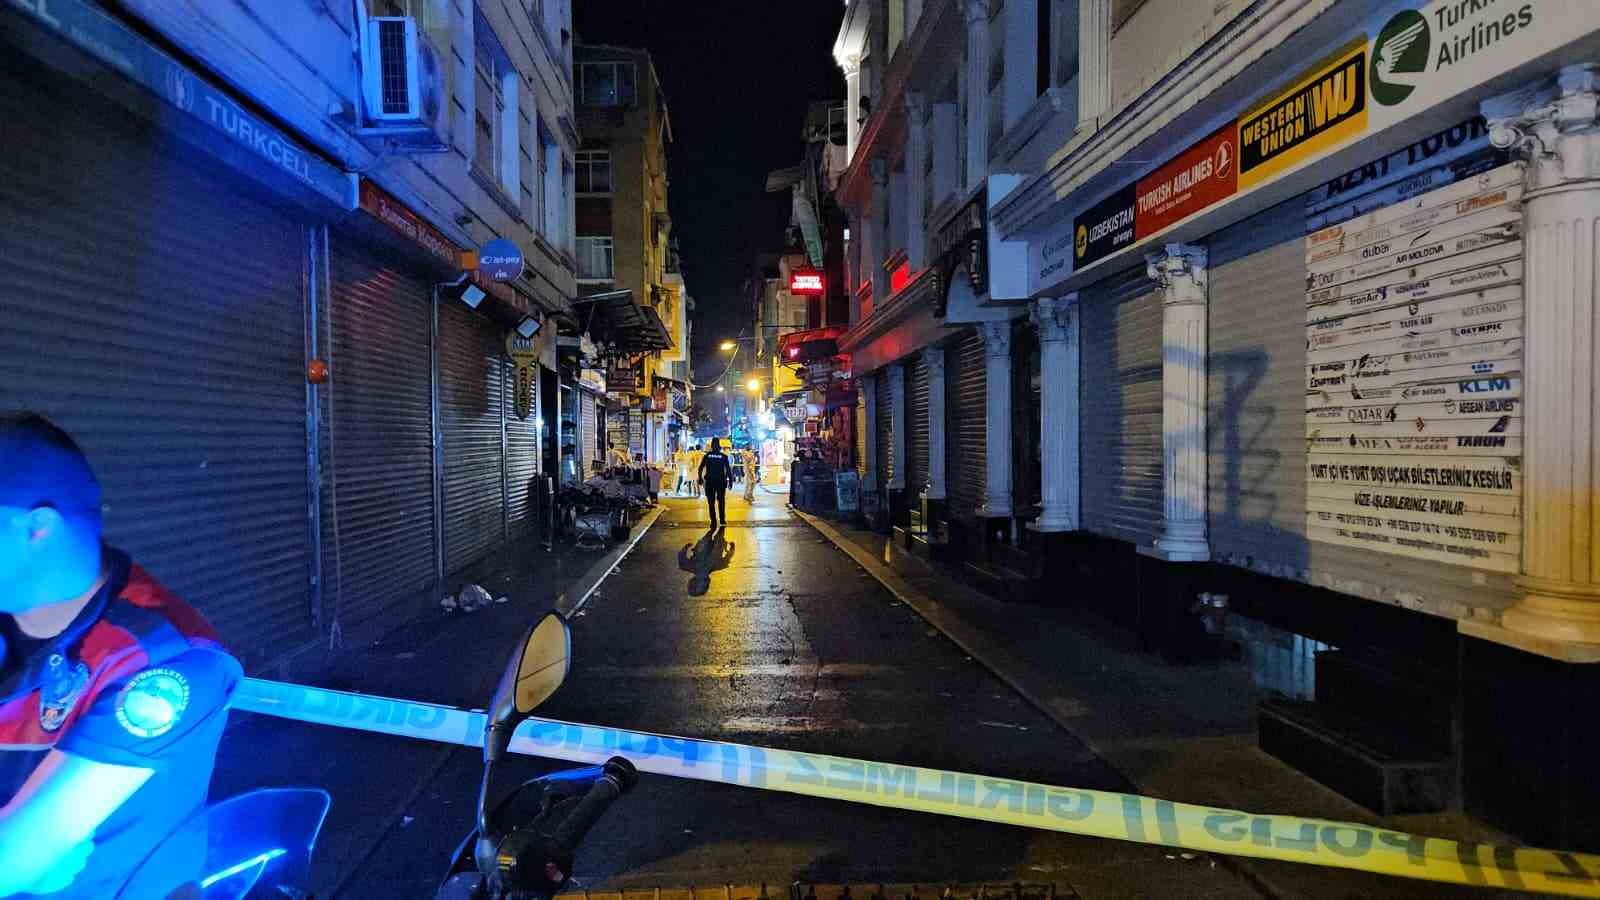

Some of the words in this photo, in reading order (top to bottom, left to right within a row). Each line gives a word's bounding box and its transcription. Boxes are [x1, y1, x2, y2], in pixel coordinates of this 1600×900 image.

[1435, 2, 1533, 72] Airlines
[1312, 64, 1356, 128] WU
[1243, 93, 1305, 147] WESTERN
[1260, 116, 1305, 157] UNION
[206, 96, 315, 185] TURKCELL
[1137, 180, 1172, 214] TURKISH
[1172, 156, 1213, 194] AIRLINES
[1089, 205, 1135, 243] UZBEKISTAN
[1409, 245, 1444, 261] MOLDOVA
[1460, 322, 1502, 335] OLYMPIC
[1459, 378, 1511, 393] KLM
[1348, 408, 1380, 423] QATAR
[1311, 464, 1328, 480] YURT
[1340, 465, 1349, 480] VE
[1350, 465, 1370, 481] YURT
[1371, 467, 1386, 484] DIŞI
[1388, 467, 1410, 487] UÇAK
[1411, 464, 1472, 488] BİLETLERİNİZ
[1473, 465, 1513, 490] KESİLİR
[1429, 500, 1465, 516] YAPILIR
